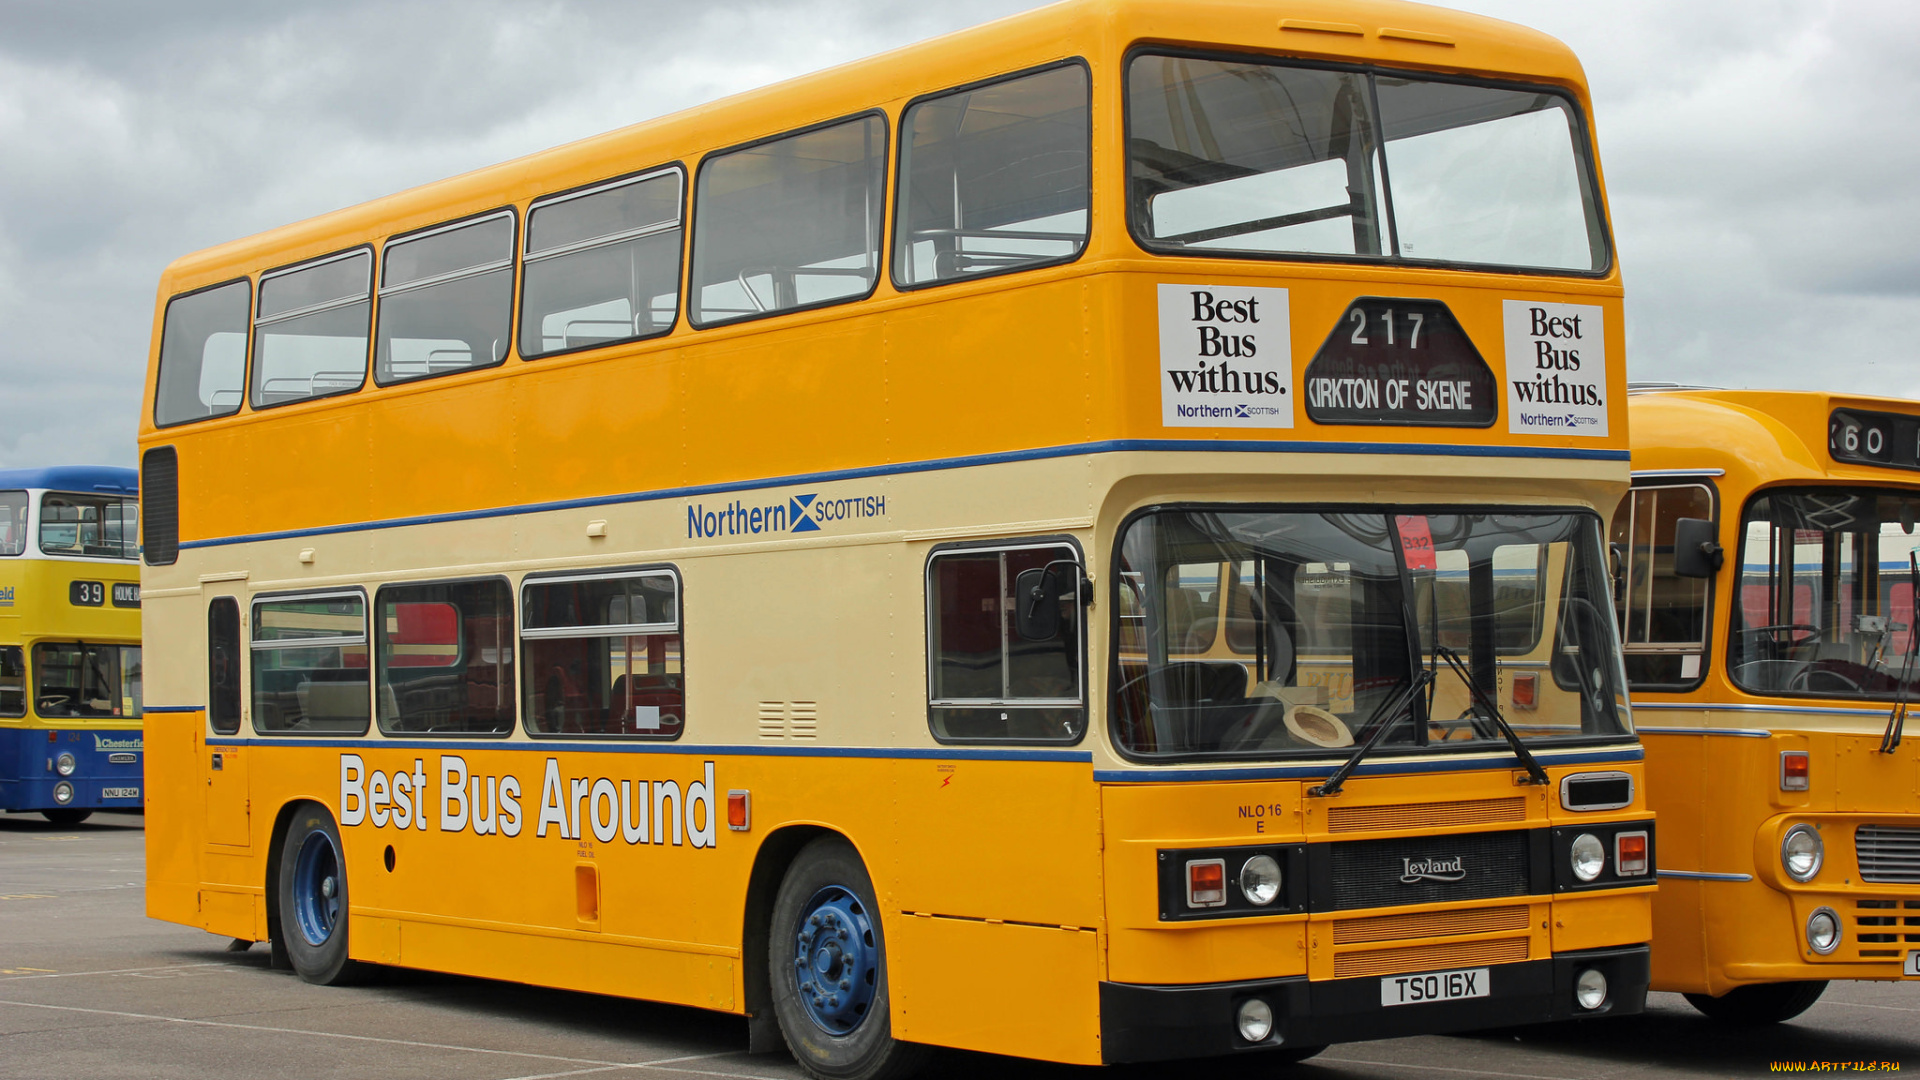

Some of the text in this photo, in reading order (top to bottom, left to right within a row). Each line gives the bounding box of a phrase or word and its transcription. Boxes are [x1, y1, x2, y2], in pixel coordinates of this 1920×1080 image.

[1190, 291, 1260, 323] Best
[1350, 308, 1424, 349] 217
[1529, 308, 1582, 339] Best
[1197, 326, 1256, 358] Bus
[1534, 341, 1581, 371] Bus
[1386, 378, 1409, 410] OF
[1416, 379, 1472, 410] SKENE
[1177, 404, 1279, 417] Northern SCOTTISH
[1521, 412, 1598, 426] Northern SCOTTISH
[687, 495, 886, 539] Northern SCOTTISH
[1403, 536, 1431, 550] B32
[80, 583, 101, 602] 39
[105, 788, 120, 797] NNU
[340, 753, 716, 849] Best Bus Around
[1238, 803, 1282, 818] NLO 16
[1256, 820, 1265, 833] E
[1400, 856, 1466, 883] Leyland
[1395, 972, 1477, 1002] TSO 16X
